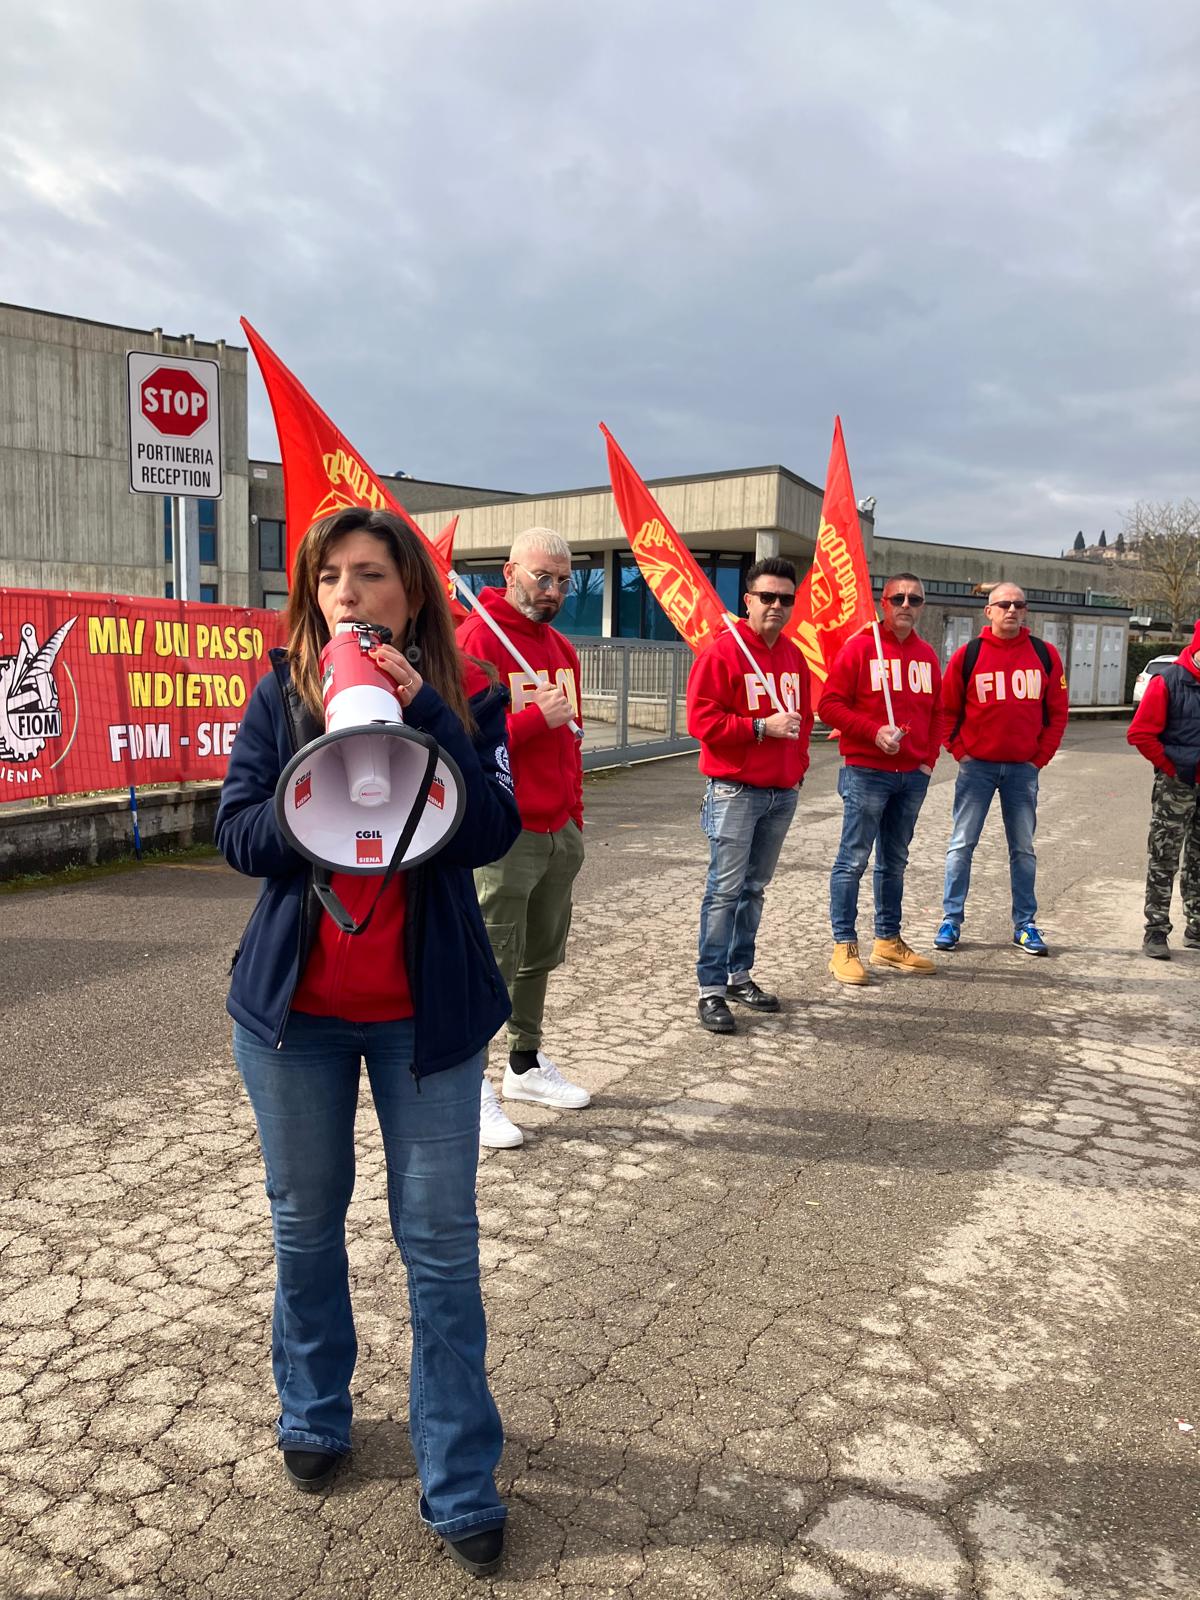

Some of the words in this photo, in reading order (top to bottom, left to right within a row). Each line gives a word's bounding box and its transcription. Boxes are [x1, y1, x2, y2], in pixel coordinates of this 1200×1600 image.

[144, 386, 205, 417] STOP
[137, 443, 214, 465] PORTINERIA
[142, 466, 211, 488] RECEPTION
[88, 616, 146, 656] MAI
[155, 620, 190, 658] UN
[196, 624, 264, 661] PASSO
[128, 671, 247, 708] INDIETRO
[975, 669, 1042, 704] FIOM
[17, 714, 59, 736] FIOM
[197, 721, 241, 757] SIE
[0, 766, 42, 784] IENA
[295, 769, 312, 786] CGIL
[355, 830, 383, 839] CGIL
